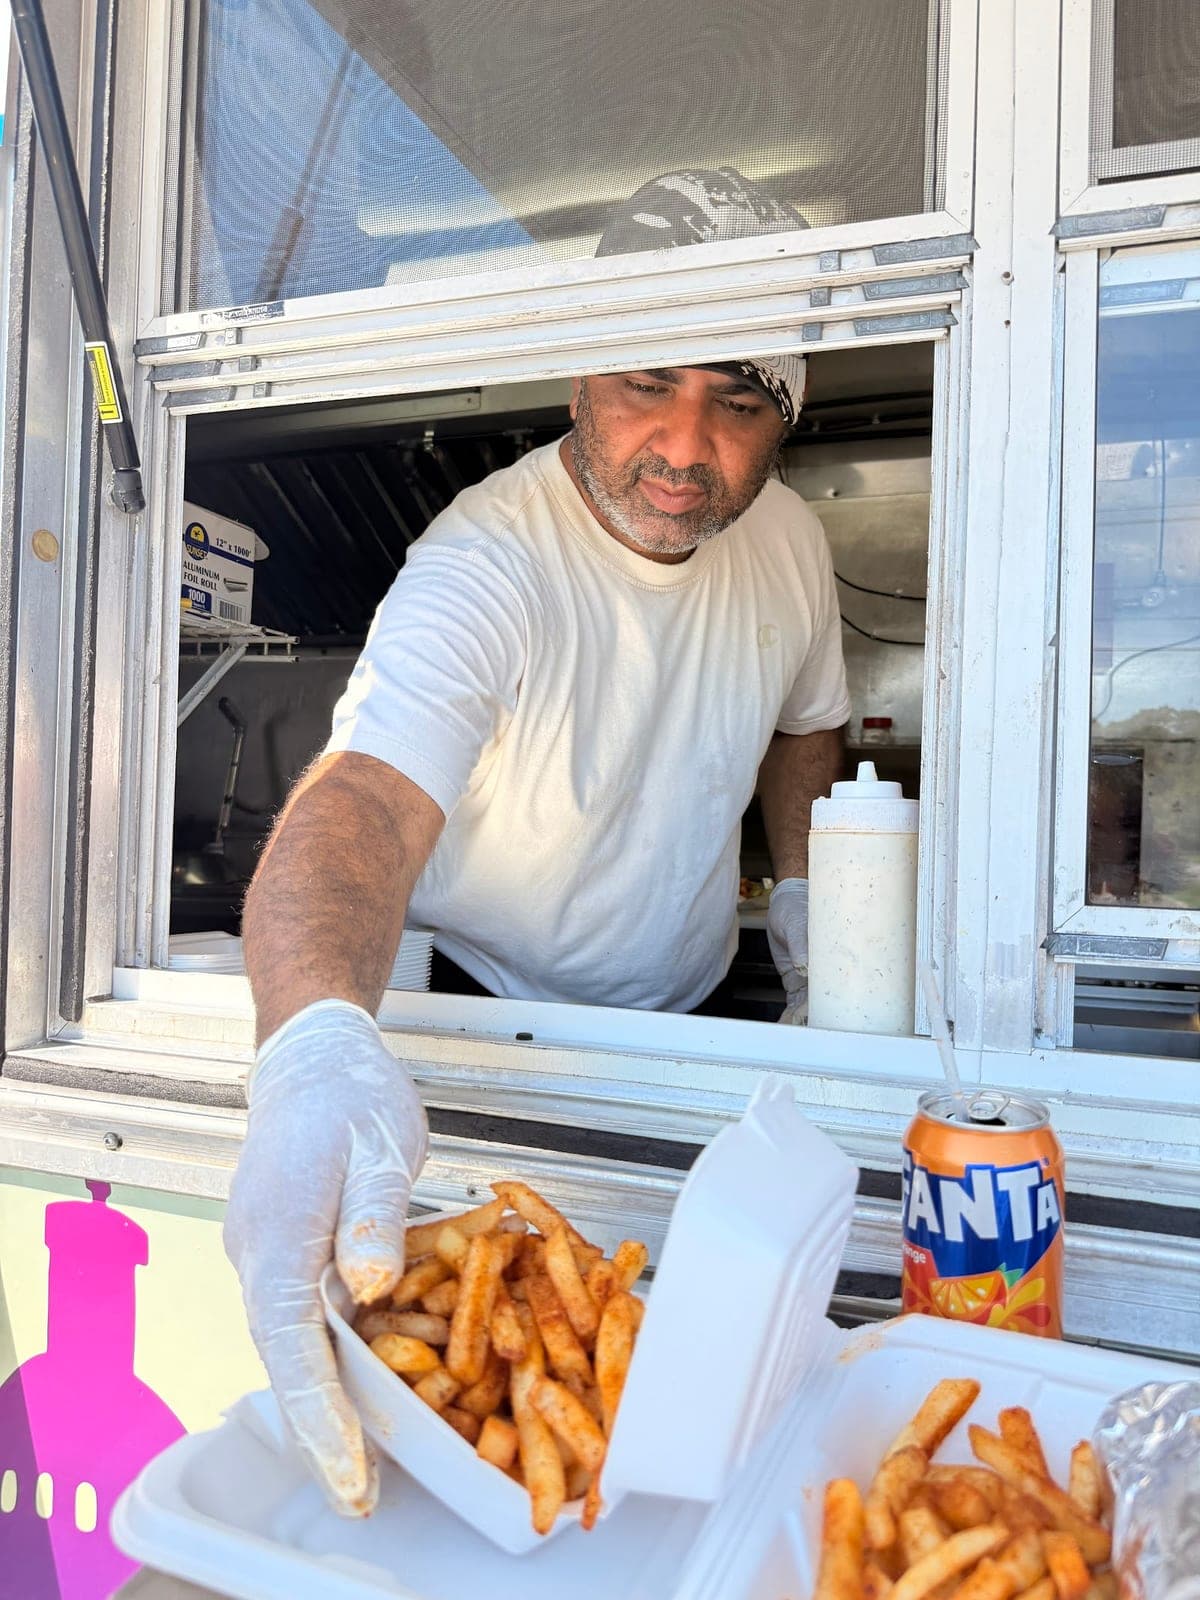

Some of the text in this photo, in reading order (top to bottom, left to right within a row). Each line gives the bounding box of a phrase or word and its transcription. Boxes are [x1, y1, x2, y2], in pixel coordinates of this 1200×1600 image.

[183, 560, 219, 581] ALUMINUM
[183, 571, 217, 591] FOIL ROLL
[188, 589, 206, 603] 1000
